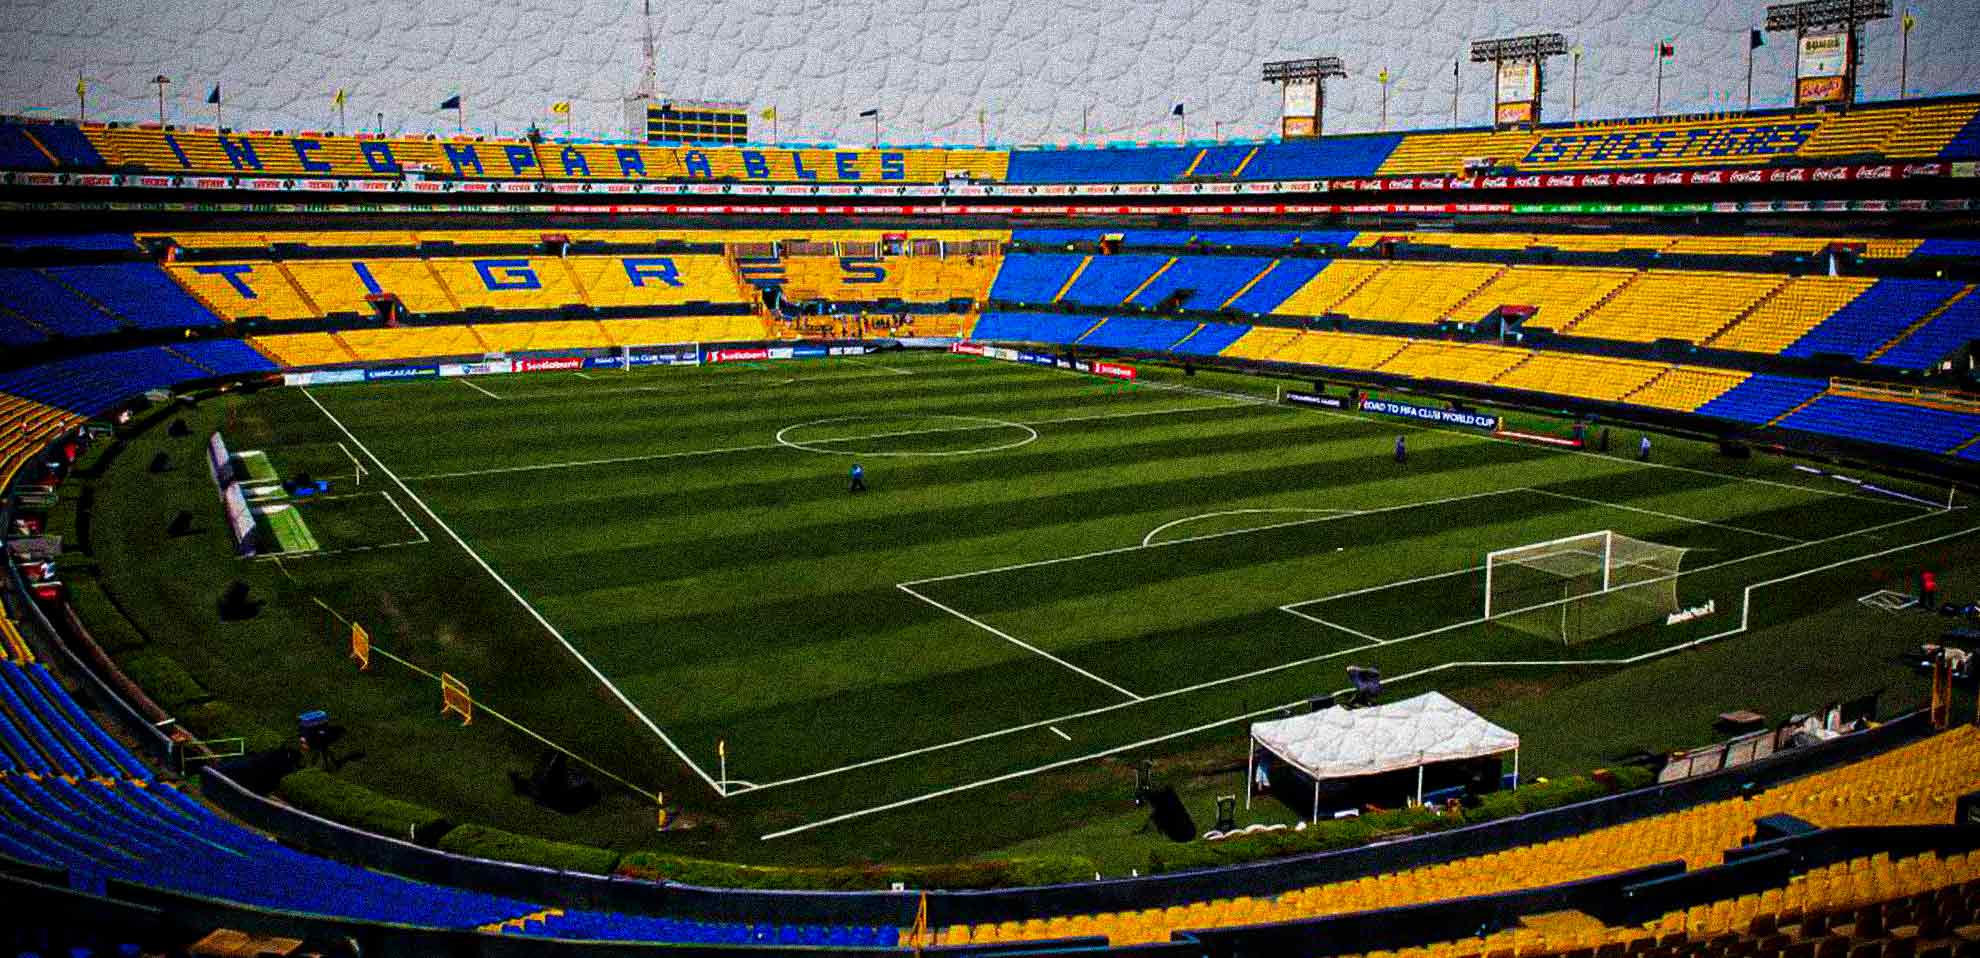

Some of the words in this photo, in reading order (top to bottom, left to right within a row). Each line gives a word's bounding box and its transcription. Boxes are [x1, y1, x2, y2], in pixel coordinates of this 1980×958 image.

[194, 257, 887, 299] TIGRES
[1387, 403, 1398, 413] TO
[1442, 411, 1474, 424] WORLD
[1475, 416, 1495, 428] CUP
